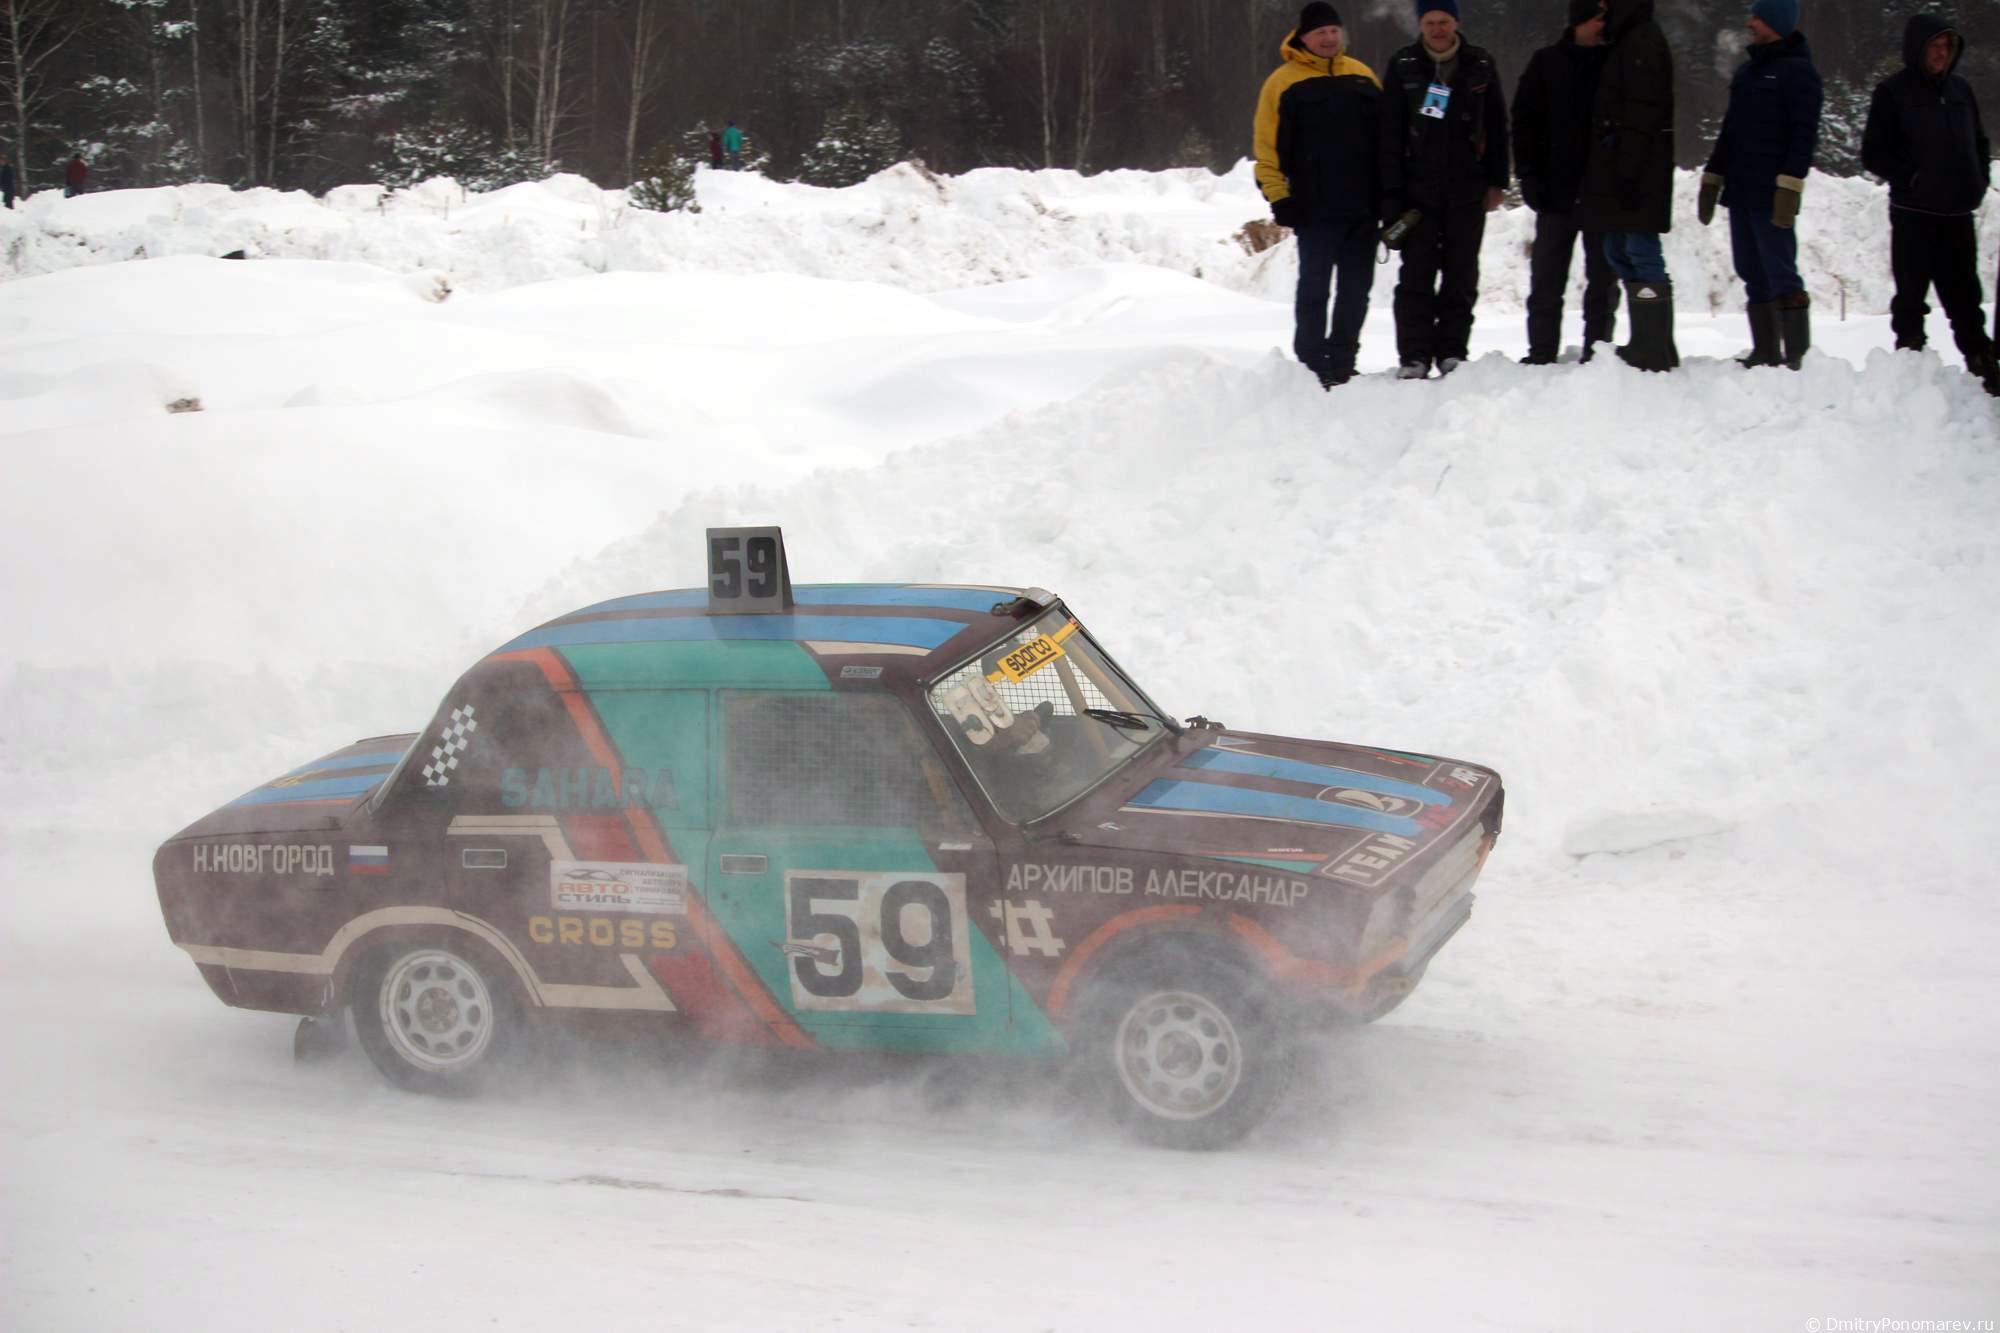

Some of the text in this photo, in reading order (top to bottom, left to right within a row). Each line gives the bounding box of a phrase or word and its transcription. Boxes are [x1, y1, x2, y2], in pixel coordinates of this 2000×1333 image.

[711, 537, 778, 599] 59
[1006, 638, 1053, 675] sparco
[943, 676, 1014, 745] 59
[501, 767, 681, 810] SAHARA
[193, 844, 335, 876] Н.НОВГОРОД
[1336, 833, 1417, 878] TEAM
[558, 893, 631, 904] СТИЛЬ
[559, 882, 630, 894] АВТО
[1006, 863, 1309, 907] АРХИПОВ АЛЕКСАНДР
[529, 916, 677, 949] CROSS
[790, 877, 956, 1001] 59
